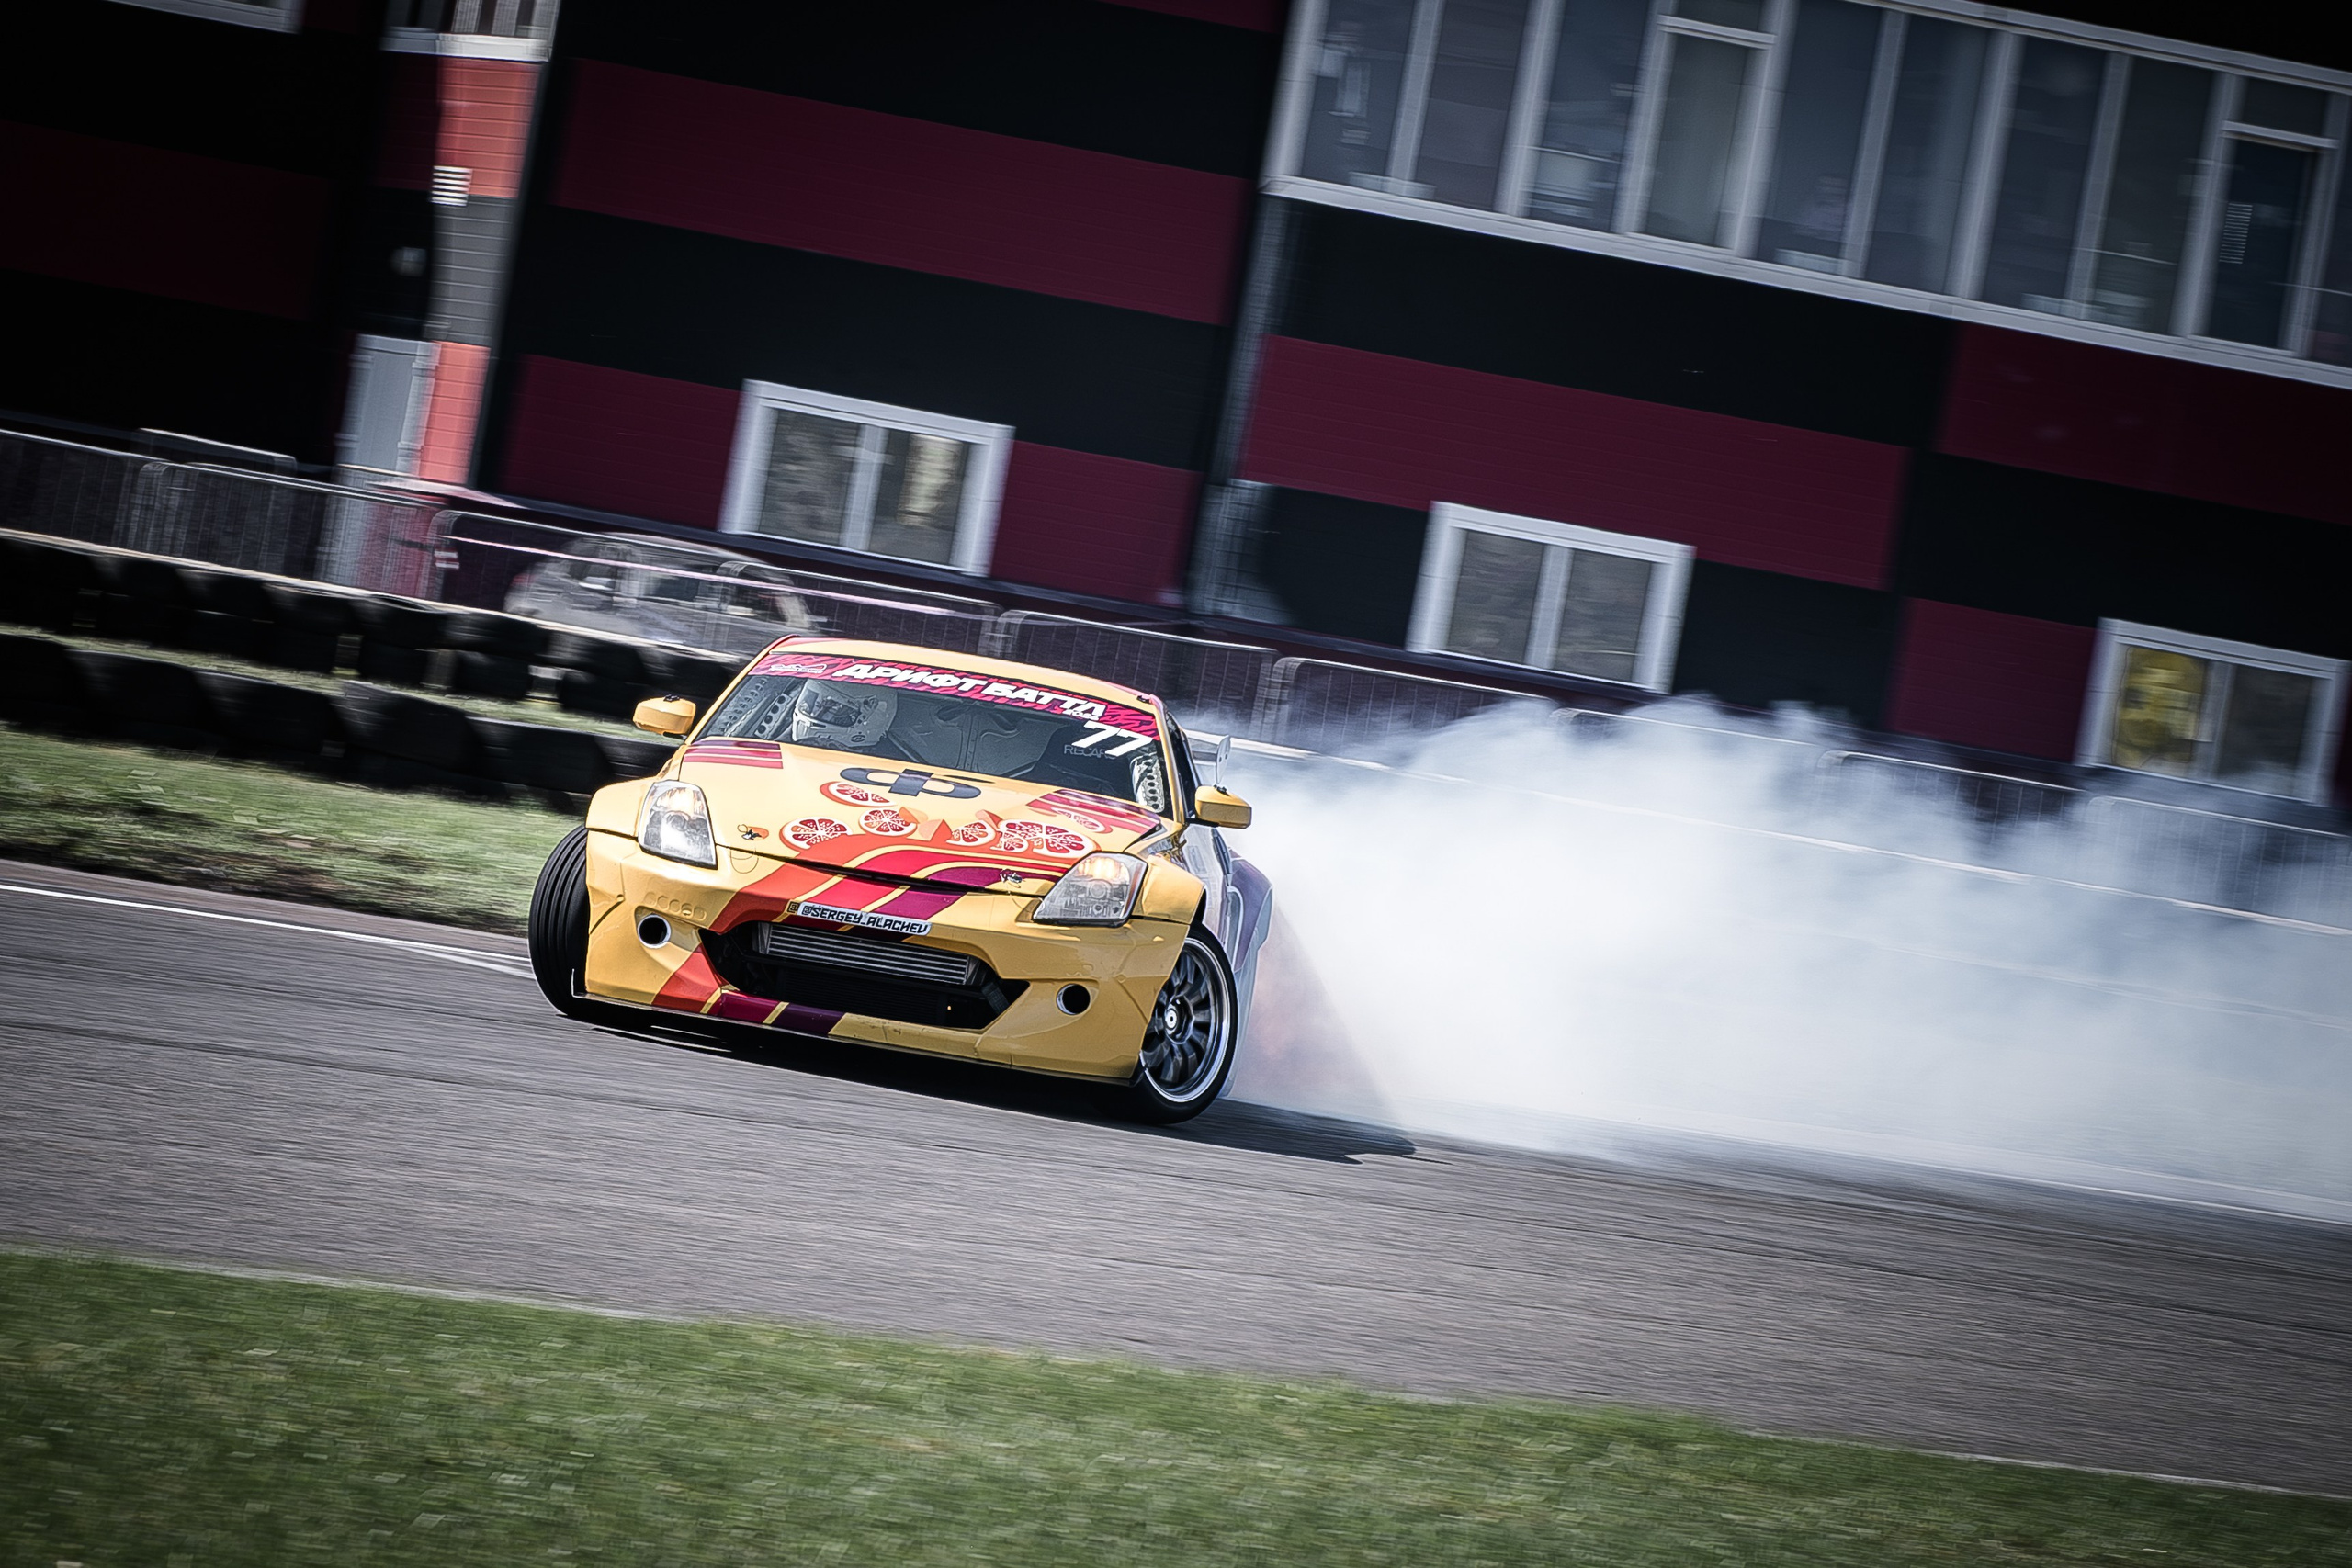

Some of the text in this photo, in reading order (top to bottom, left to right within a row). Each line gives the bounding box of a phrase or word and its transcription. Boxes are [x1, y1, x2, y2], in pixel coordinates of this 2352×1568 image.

[831, 663, 989, 692] ДРИФТ
[1063, 744, 1117, 761] RECAR
[1071, 720, 1154, 757] 77
